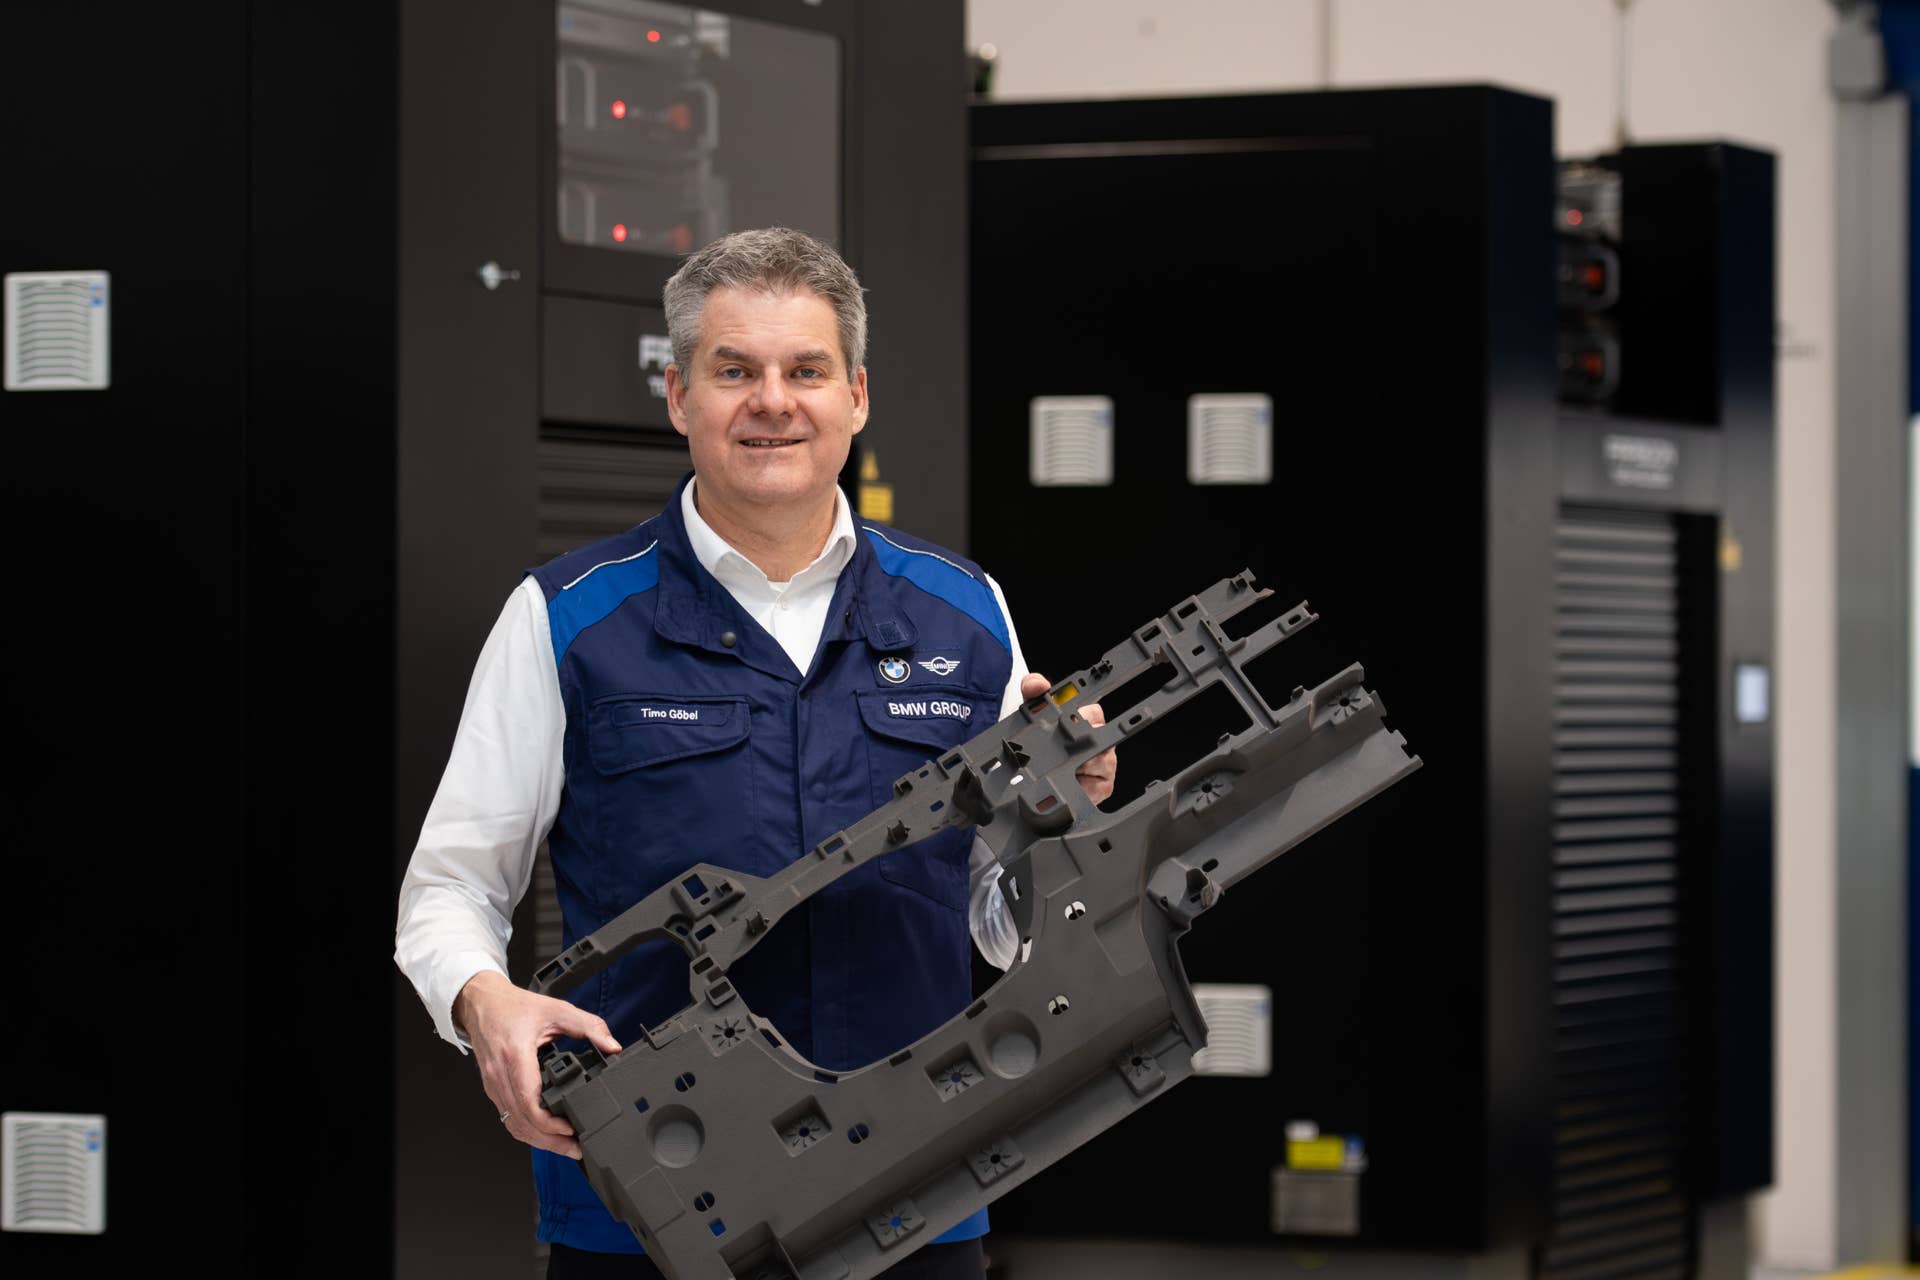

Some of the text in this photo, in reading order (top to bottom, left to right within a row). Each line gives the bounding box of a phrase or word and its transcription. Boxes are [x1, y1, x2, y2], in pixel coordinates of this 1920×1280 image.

[640, 708, 698, 720] Timo Göbel
[888, 701, 971, 720] BMW GROUP
